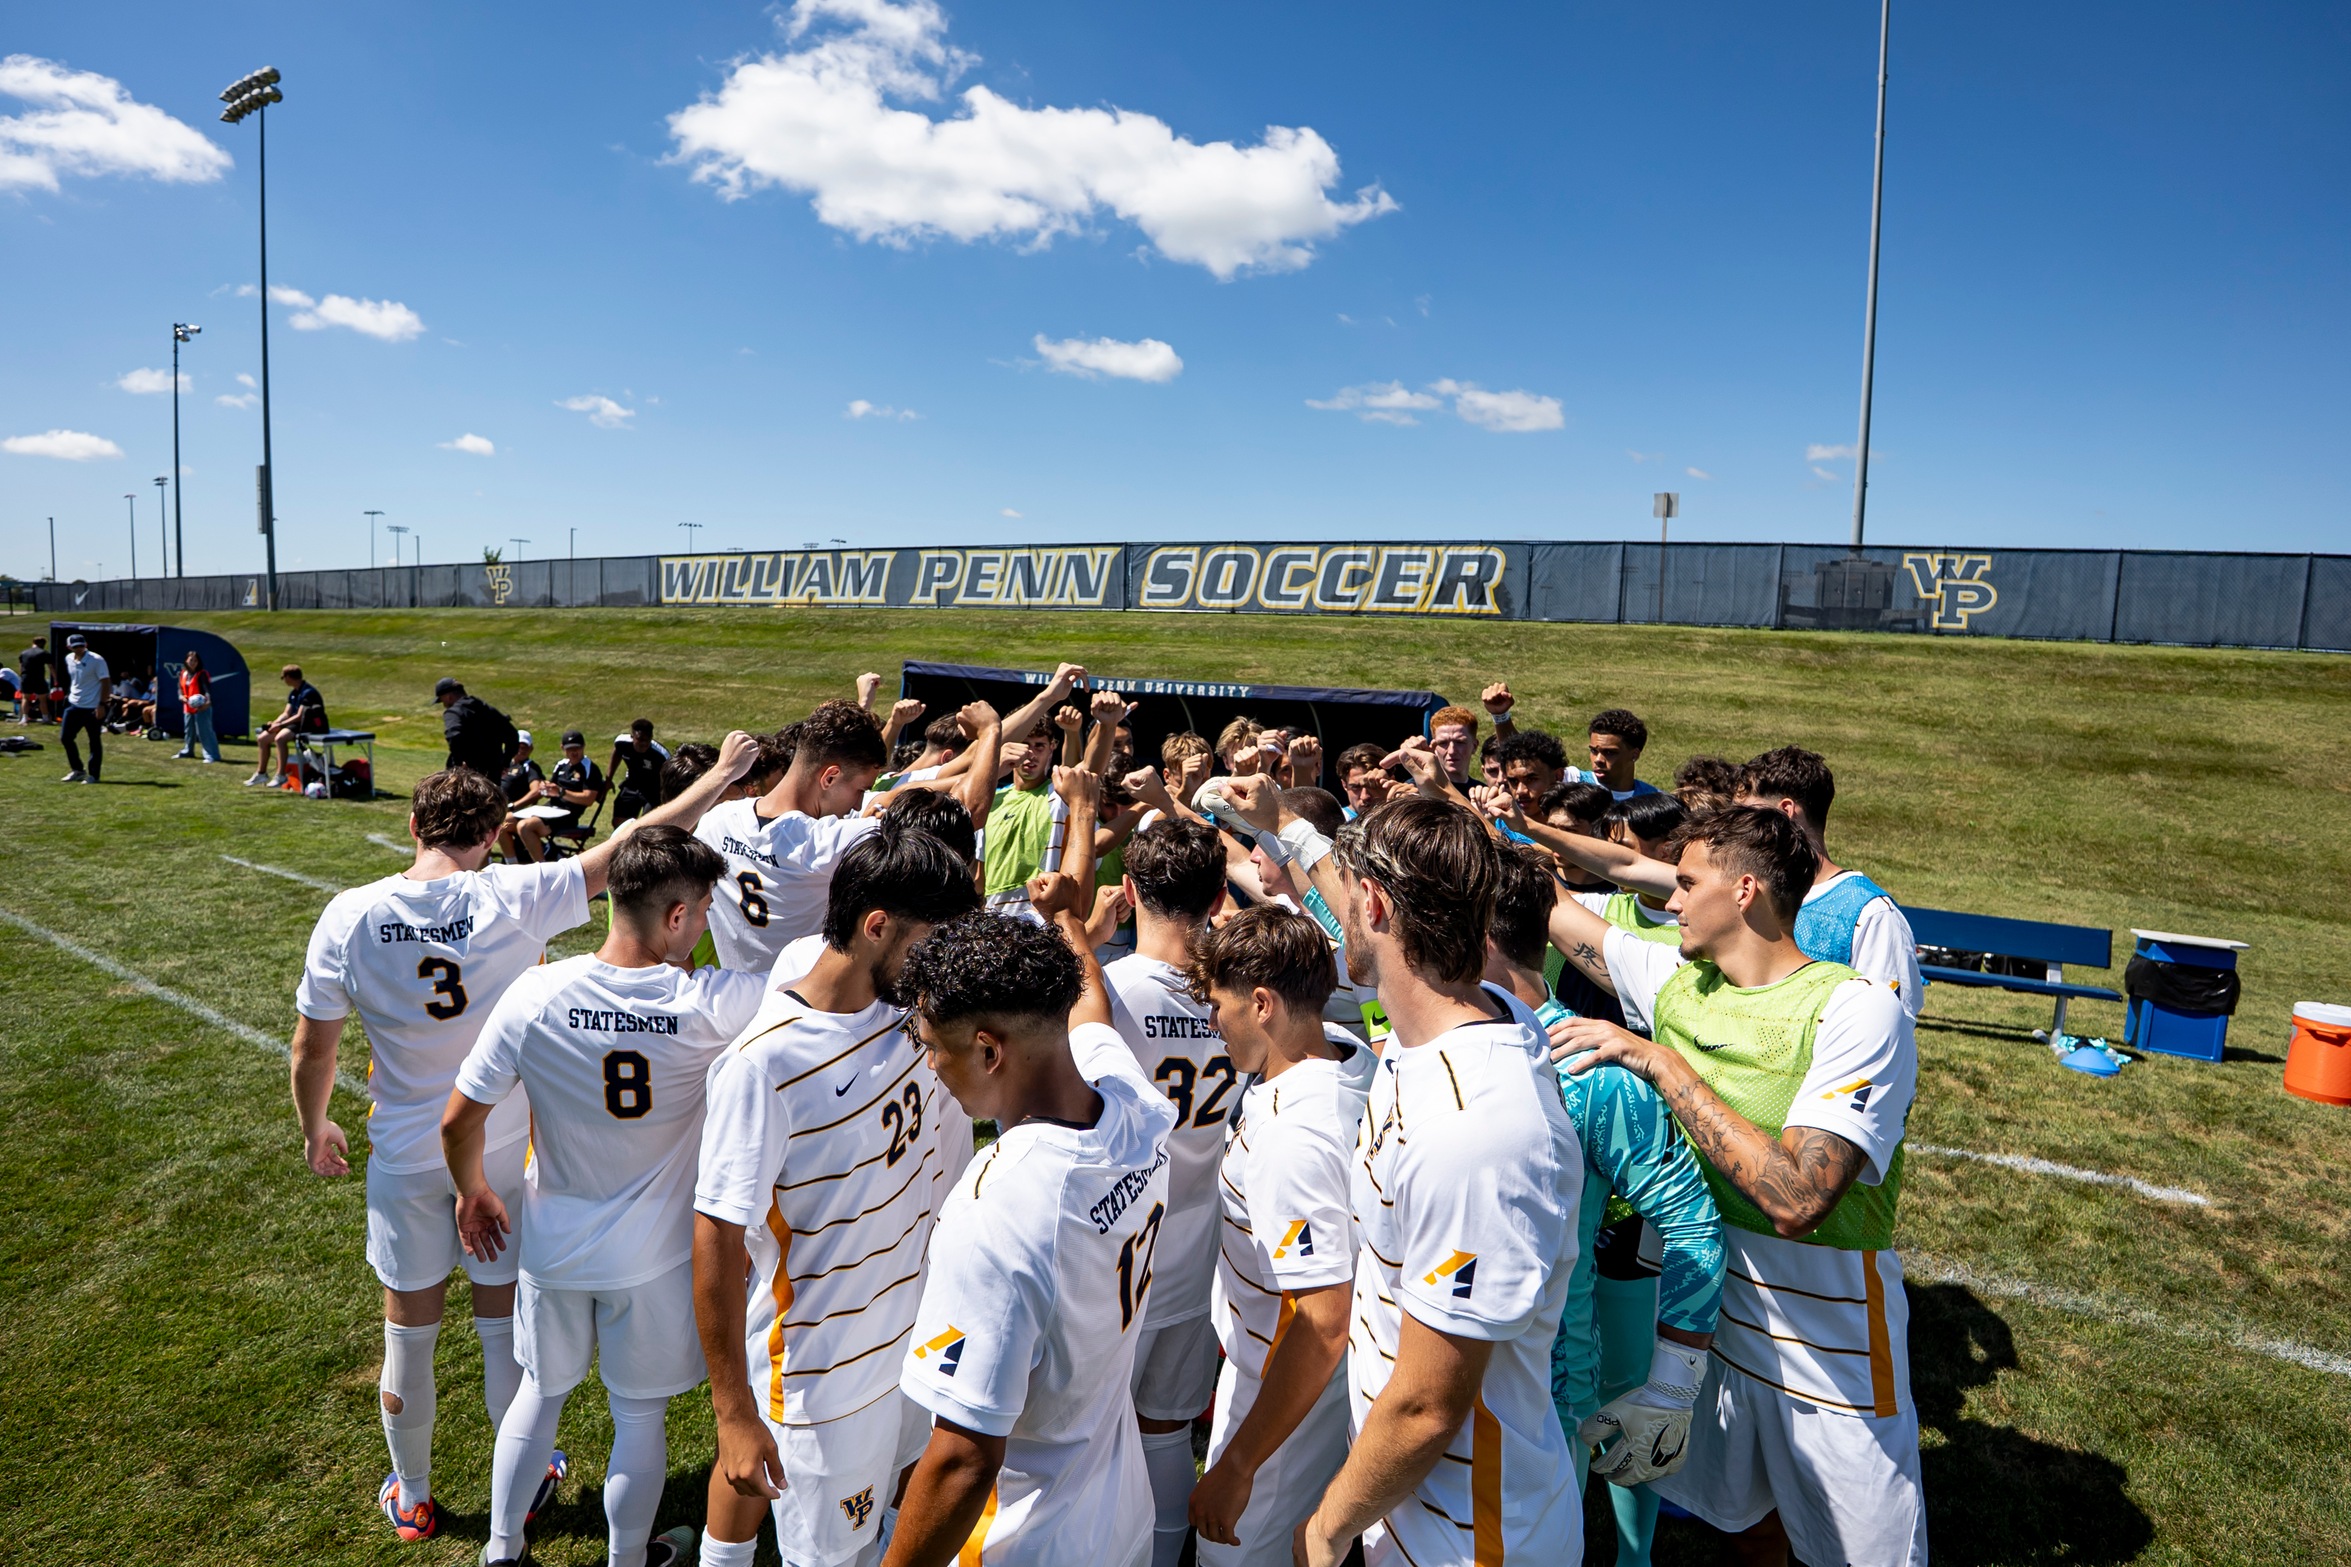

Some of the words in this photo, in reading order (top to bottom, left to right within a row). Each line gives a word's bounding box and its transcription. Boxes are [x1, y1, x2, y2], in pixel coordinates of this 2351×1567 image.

[659, 551, 897, 603] WILLIAM
[910, 547, 1121, 605] PENN
[1140, 546, 1505, 614] SOCCER
[1097, 679, 1136, 691] PENN
[1145, 681, 1249, 698] UNIVERSITY
[736, 870, 769, 928] 6
[417, 956, 469, 1022] 3
[569, 1008, 678, 1035] STATESMEN
[602, 1049, 653, 1120] 8
[1154, 1056, 1237, 1131] 32
[881, 1079, 921, 1169] 23
